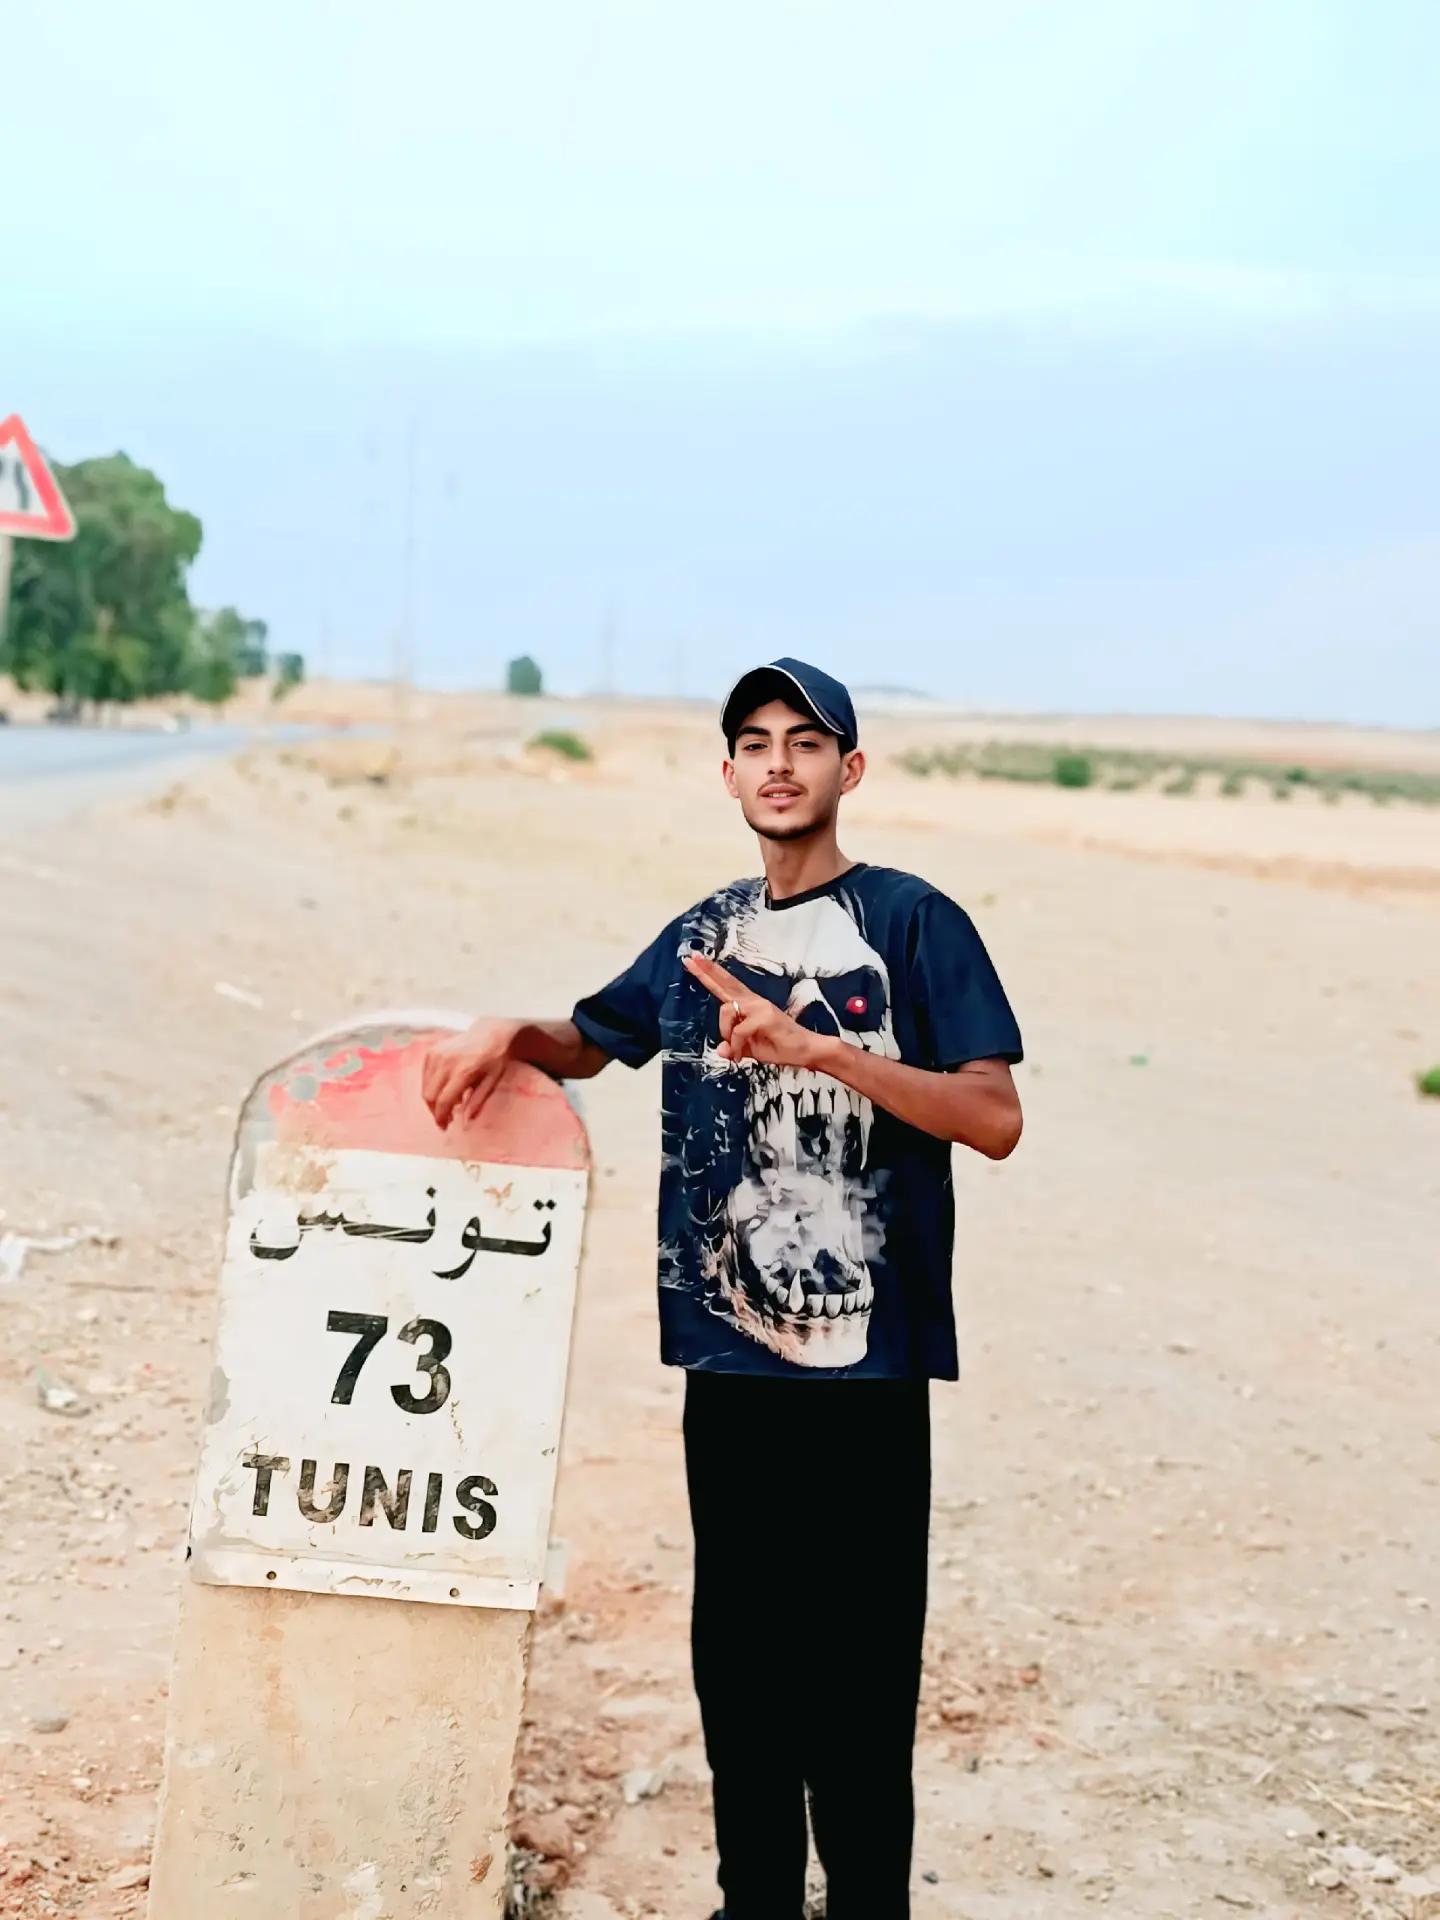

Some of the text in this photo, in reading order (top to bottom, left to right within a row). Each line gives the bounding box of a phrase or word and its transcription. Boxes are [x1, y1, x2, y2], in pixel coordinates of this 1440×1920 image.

[250, 1186, 556, 1280] تونس
[326, 1310, 453, 1415] 73
[243, 1453, 499, 1540] TUNIS
